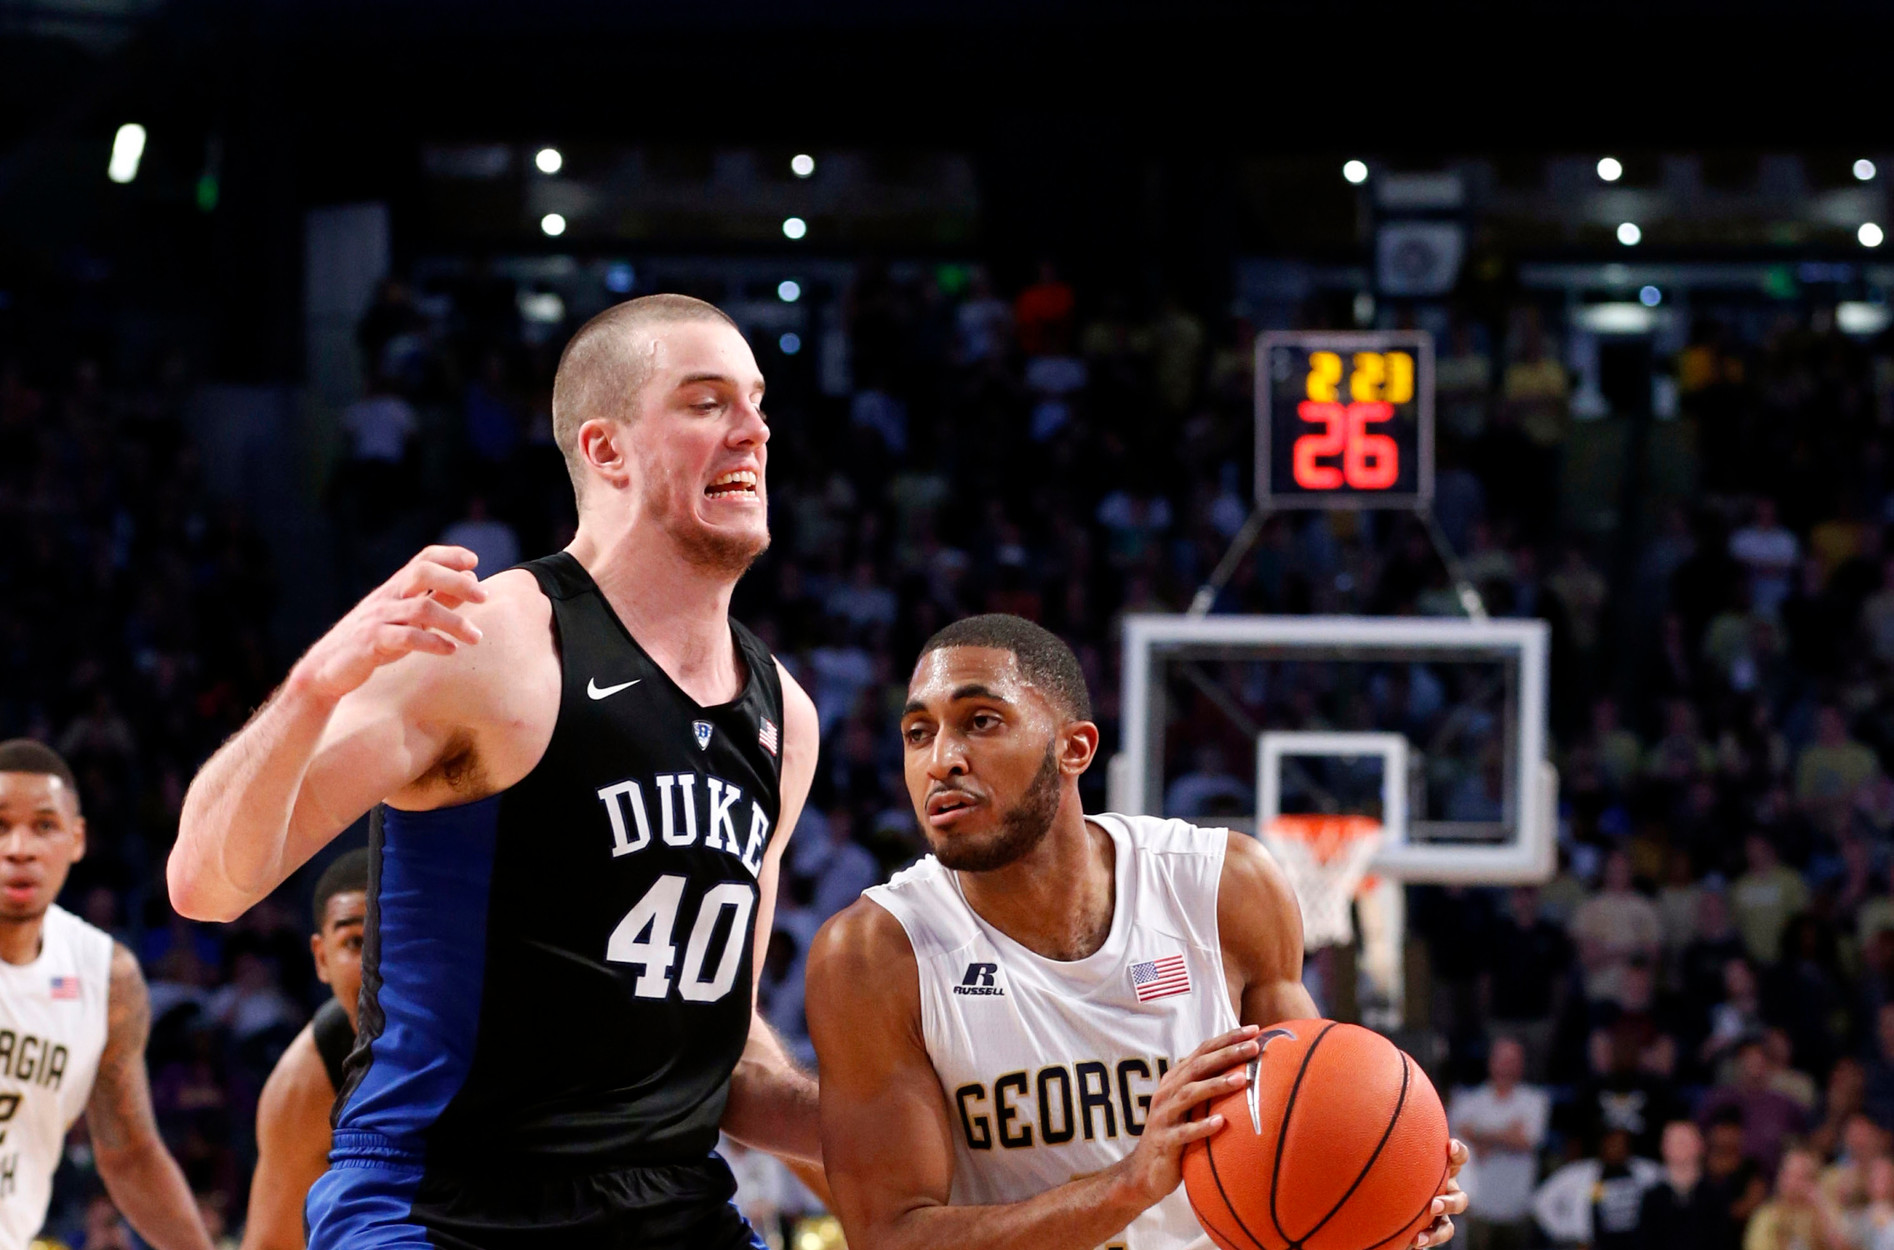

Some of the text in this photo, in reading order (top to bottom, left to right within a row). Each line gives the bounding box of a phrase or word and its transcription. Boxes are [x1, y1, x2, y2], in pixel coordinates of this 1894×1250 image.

[1293, 399, 1399, 490] 26
[596, 771, 770, 880] DUKE
[605, 873, 755, 1003] 40
[962, 963, 998, 986] R
[953, 985, 1005, 996] RUSSELL
